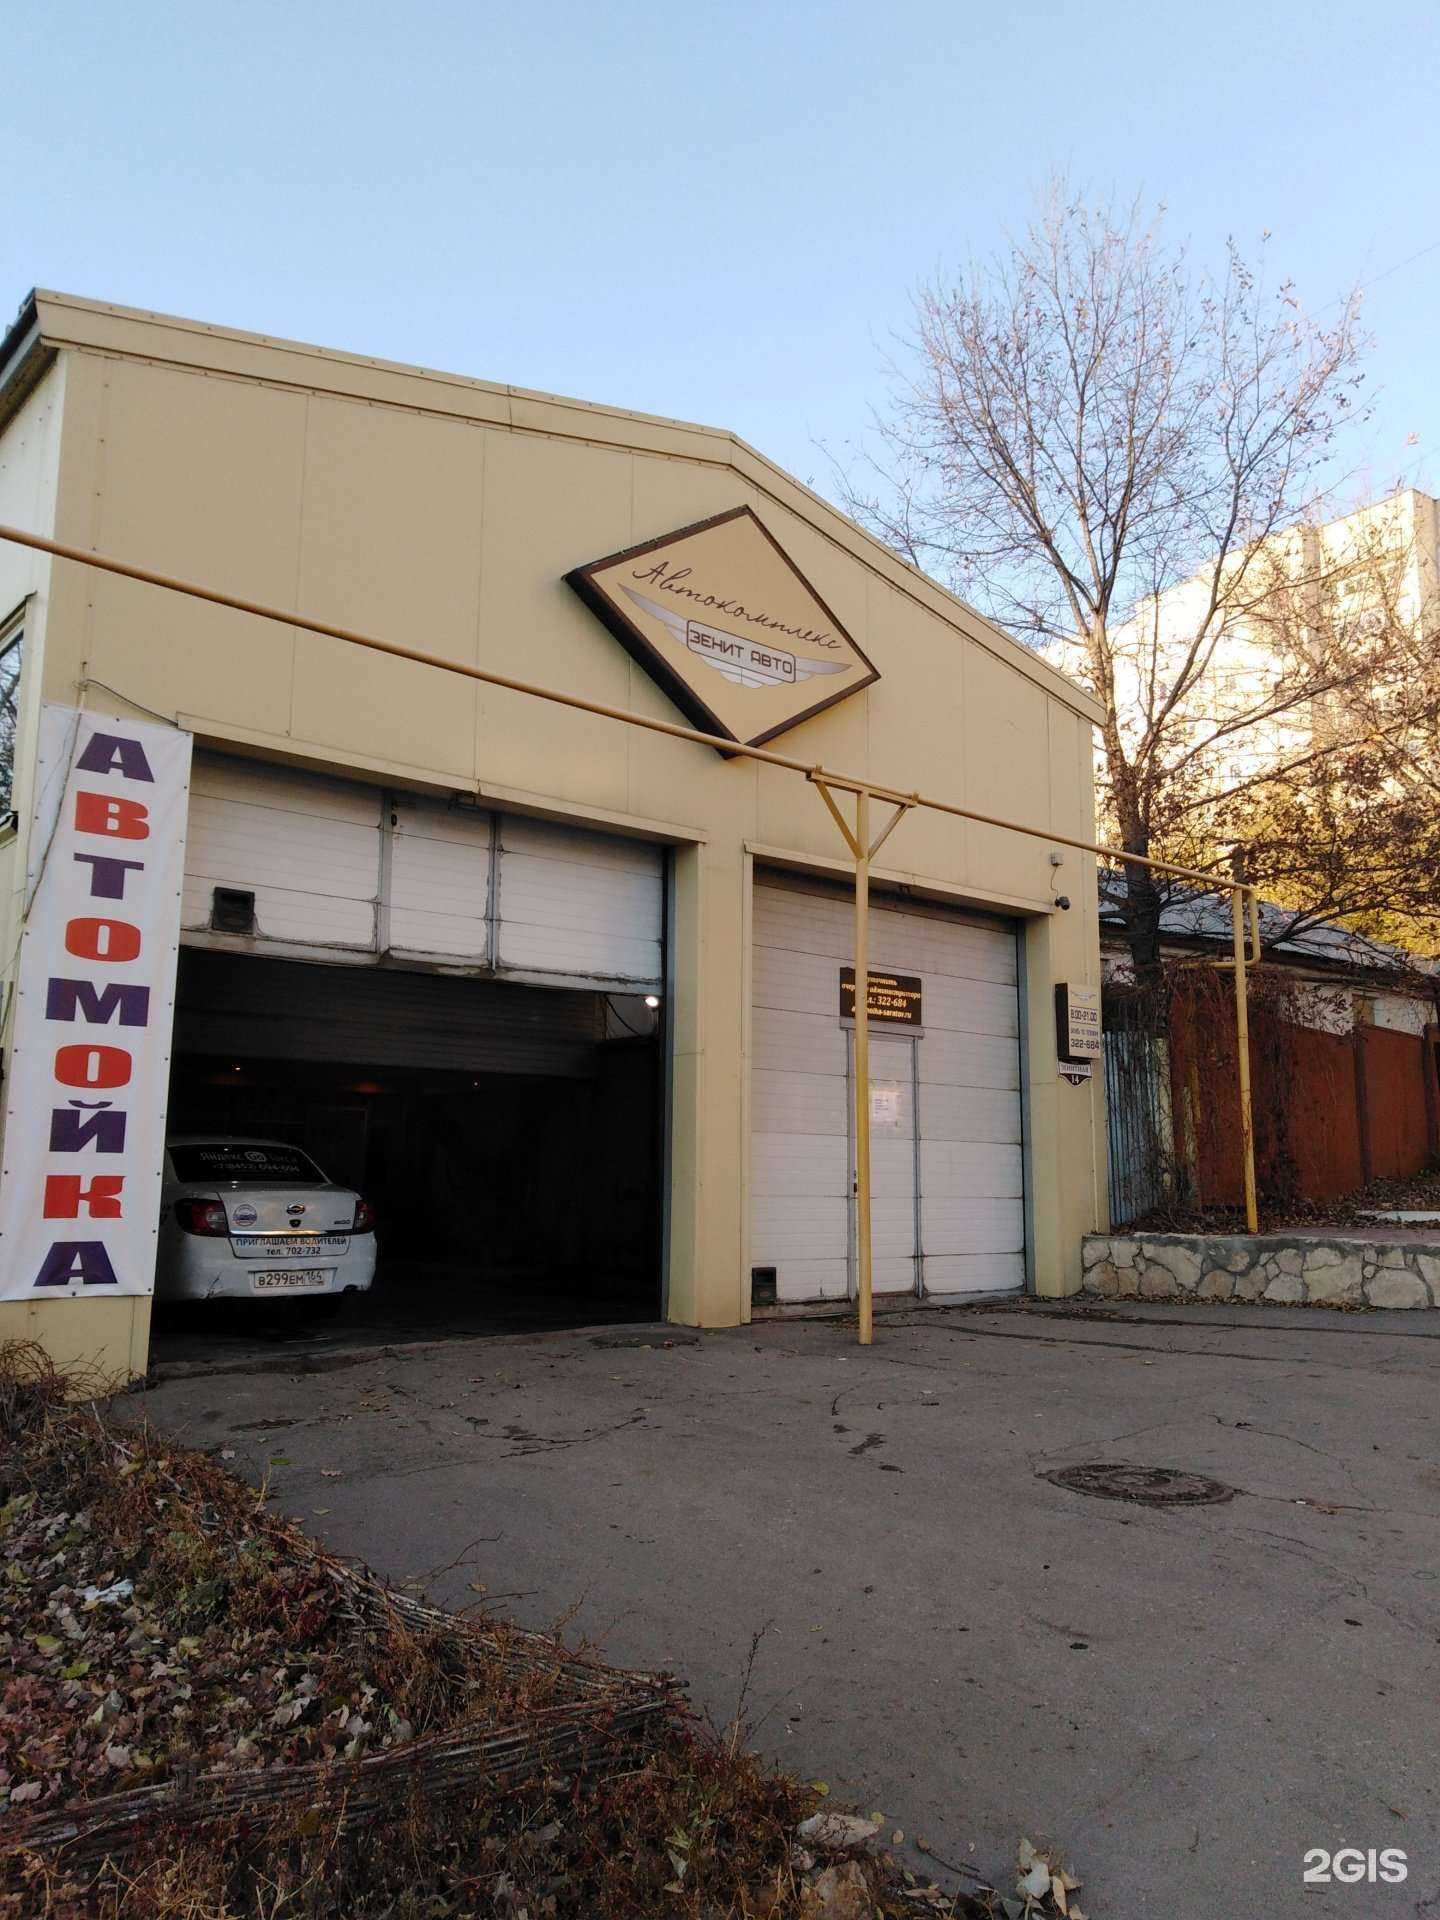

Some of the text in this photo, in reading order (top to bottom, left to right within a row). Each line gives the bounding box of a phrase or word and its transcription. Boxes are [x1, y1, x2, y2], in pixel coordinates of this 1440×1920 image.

[632, 561, 842, 649] Автокомплекс
[690, 629, 792, 675] ЗЕНИТ АВТО
[33, 731, 155, 1288] АВТОМОЙКА
[1071, 1075, 1079, 1084] 14
[236, 1236, 347, 1246] ПРИГЛАШАЕМ ВОДИТЕЛЕЙ
[286, 1246, 321, 1255] 702-732
